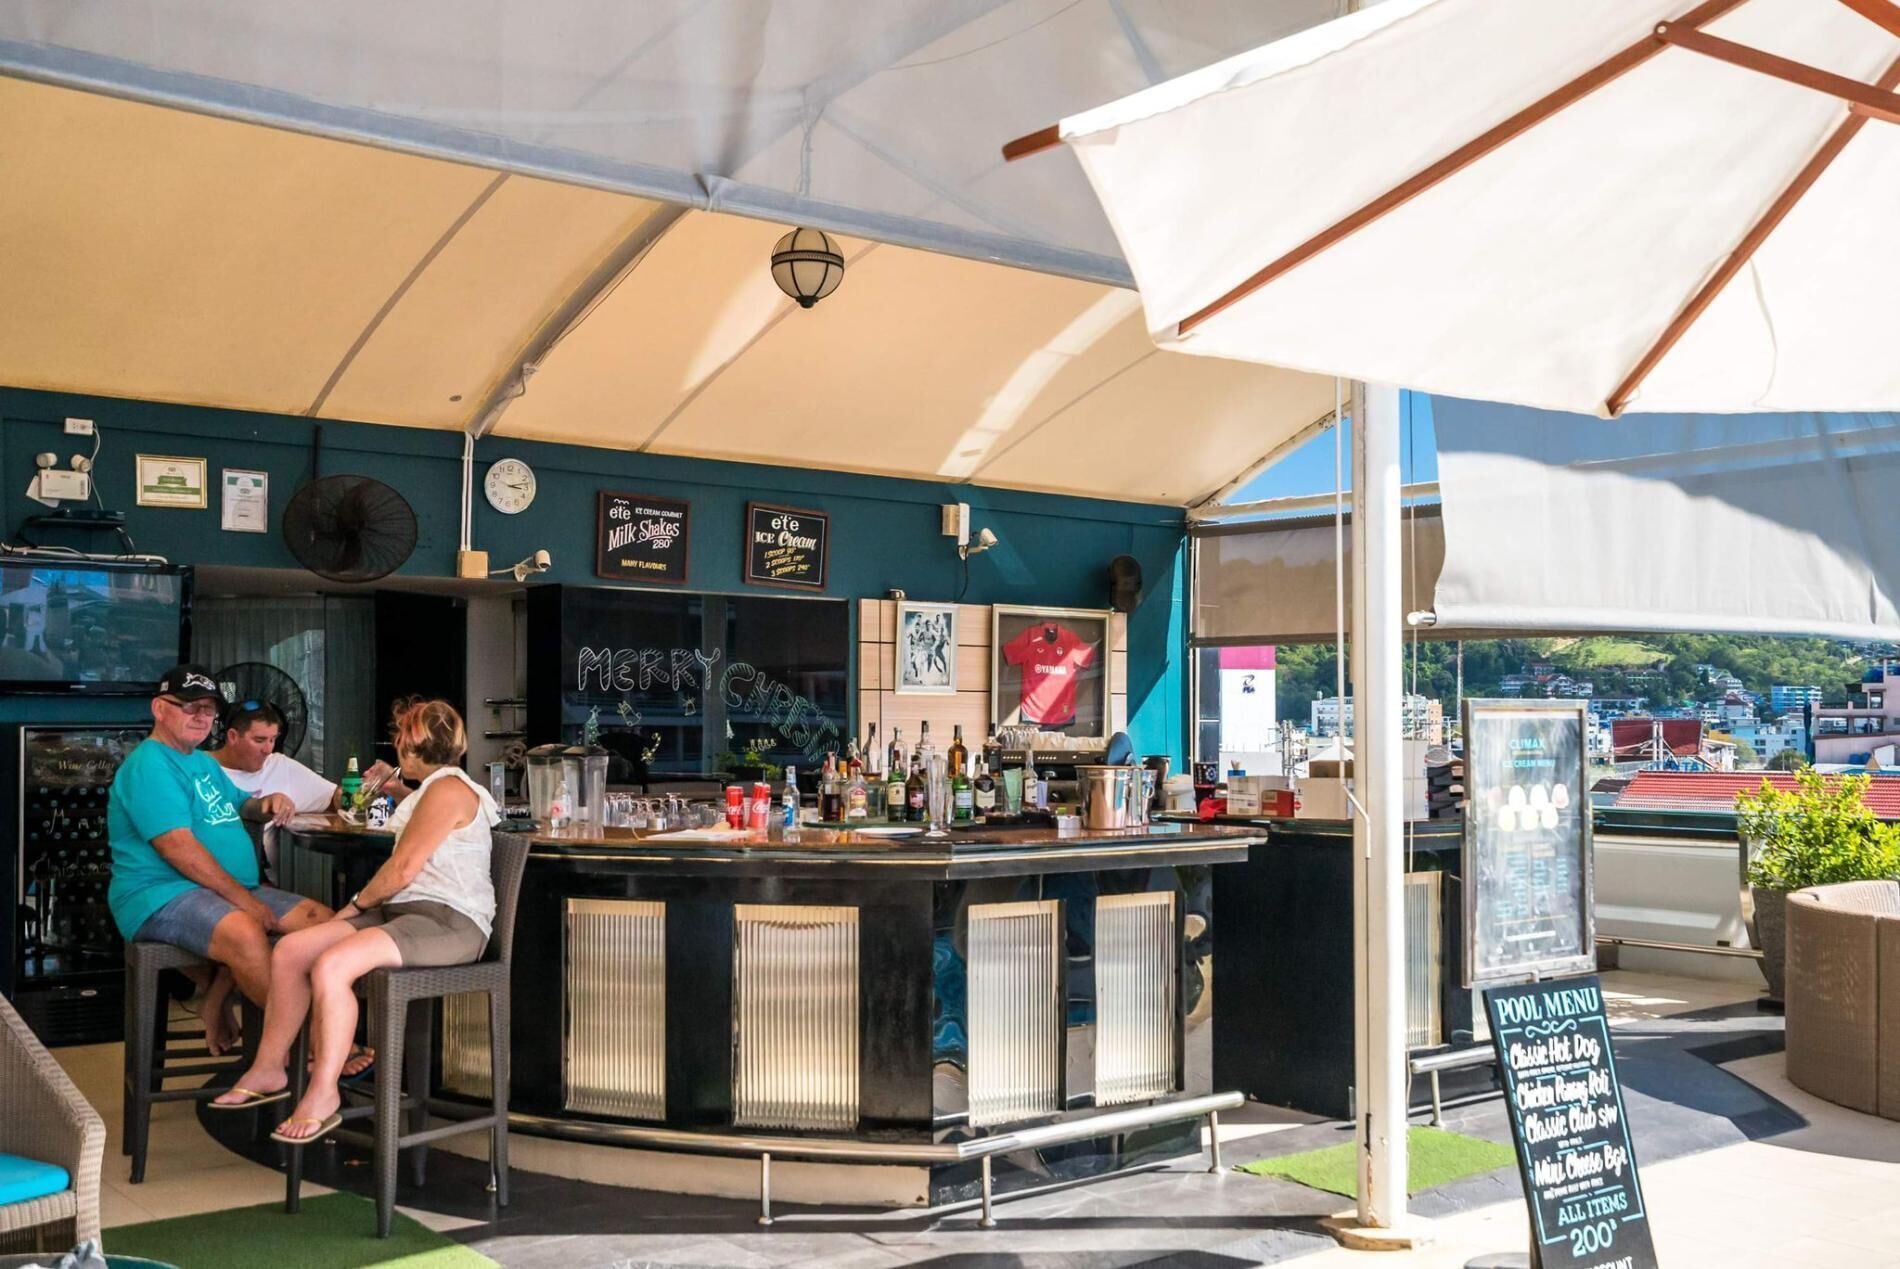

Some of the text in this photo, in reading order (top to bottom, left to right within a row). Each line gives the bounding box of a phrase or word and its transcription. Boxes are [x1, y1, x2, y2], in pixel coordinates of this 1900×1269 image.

[608, 518, 680, 552] Milk Shakes
[755, 531, 817, 551] ICE Cream
[621, 559, 667, 571] MANY FLAVOURS
[578, 646, 721, 691] MERRY
[59, 760, 81, 769] Wine
[1494, 987, 1599, 1025] POOL MENU
[1510, 1033, 1601, 1070] Classic Hot Dog
[1525, 1112, 1569, 1144] Classic
[1568, 1103, 1597, 1134] Club
[1534, 1154, 1566, 1187] Mini
[1558, 1192, 1628, 1226] ALL ITEMS
